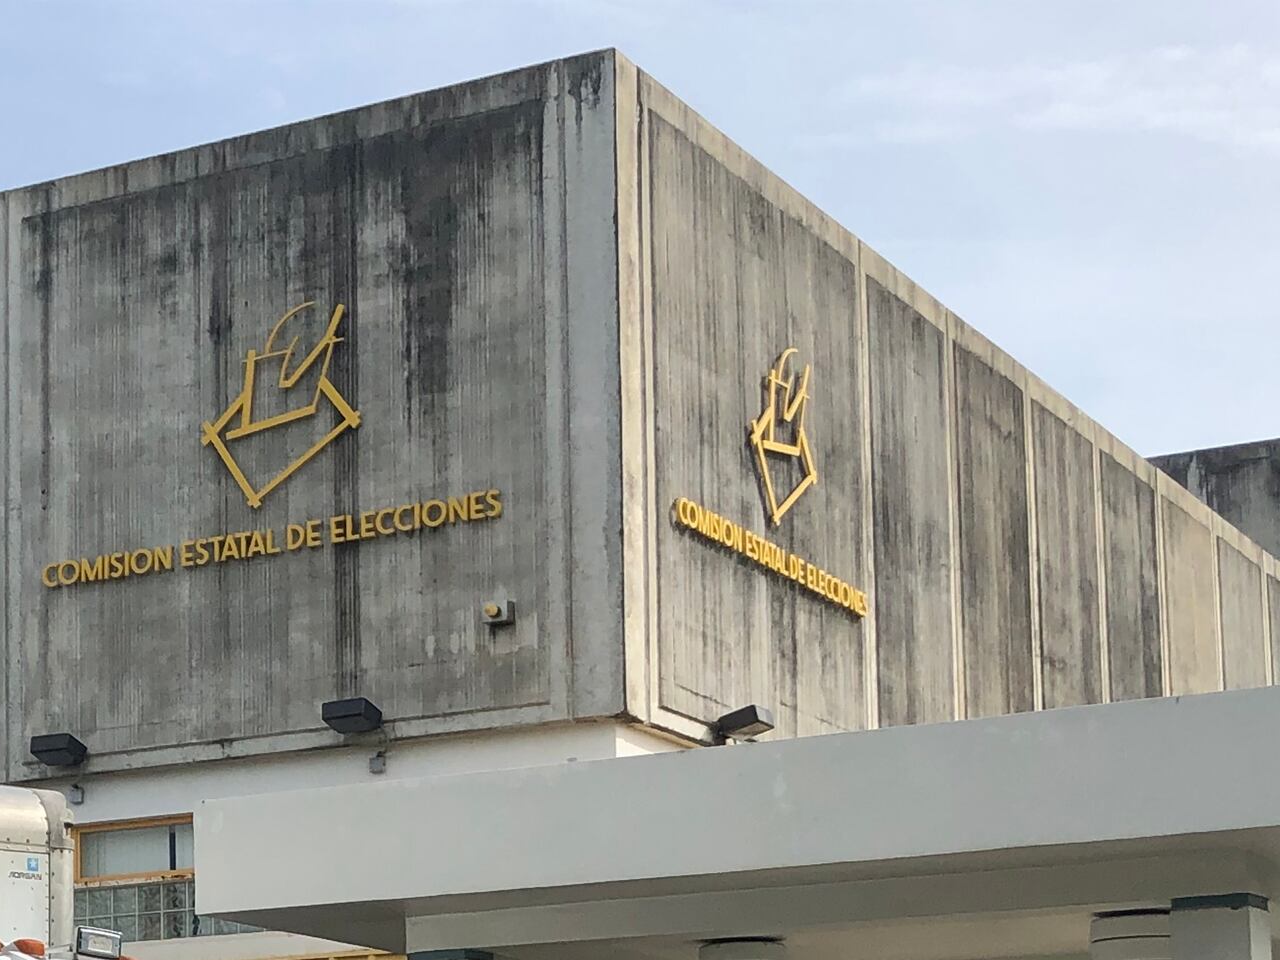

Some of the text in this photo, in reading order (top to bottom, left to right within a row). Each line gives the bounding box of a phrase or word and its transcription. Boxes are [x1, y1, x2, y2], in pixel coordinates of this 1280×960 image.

[41, 489, 503, 589] COMISION ESTATAL DE ELECCIONES
[676, 497, 869, 618] COMISION ESTATAL DE ELECCIONES
